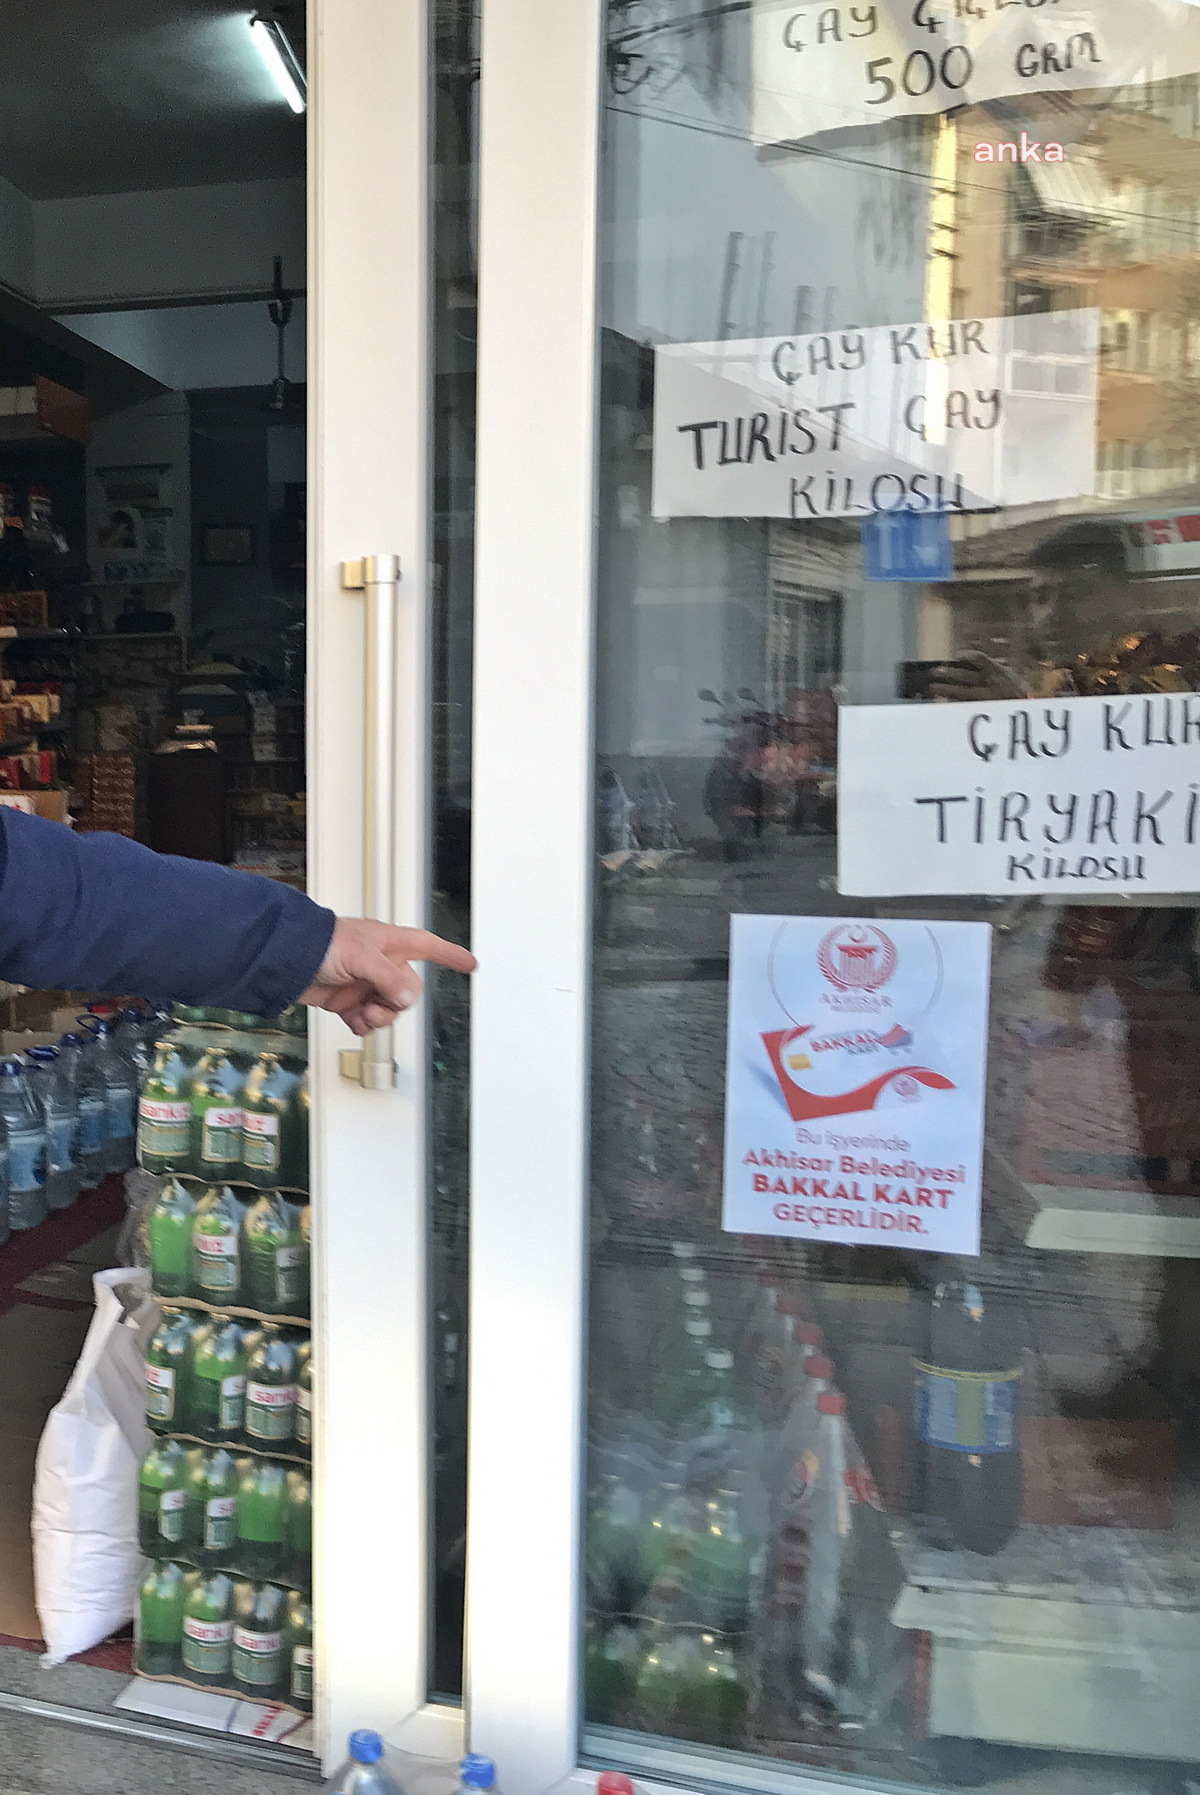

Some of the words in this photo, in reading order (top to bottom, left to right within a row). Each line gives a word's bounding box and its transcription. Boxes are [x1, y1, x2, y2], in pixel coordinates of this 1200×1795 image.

[863, 45, 974, 105] 500
[1015, 31, 1102, 78] GRM
[771, 333, 867, 386] ÇAY
[902, 387, 1003, 443] ÇAY
[967, 708, 1072, 762] ÇAY
[795, 1127, 822, 1146] Bu
[741, 1148, 834, 1174] Akhisar
[838, 1154, 968, 1186] Belediyesi
[752, 1172, 866, 1203] BAKKAL
[872, 1182, 955, 1210] KART
